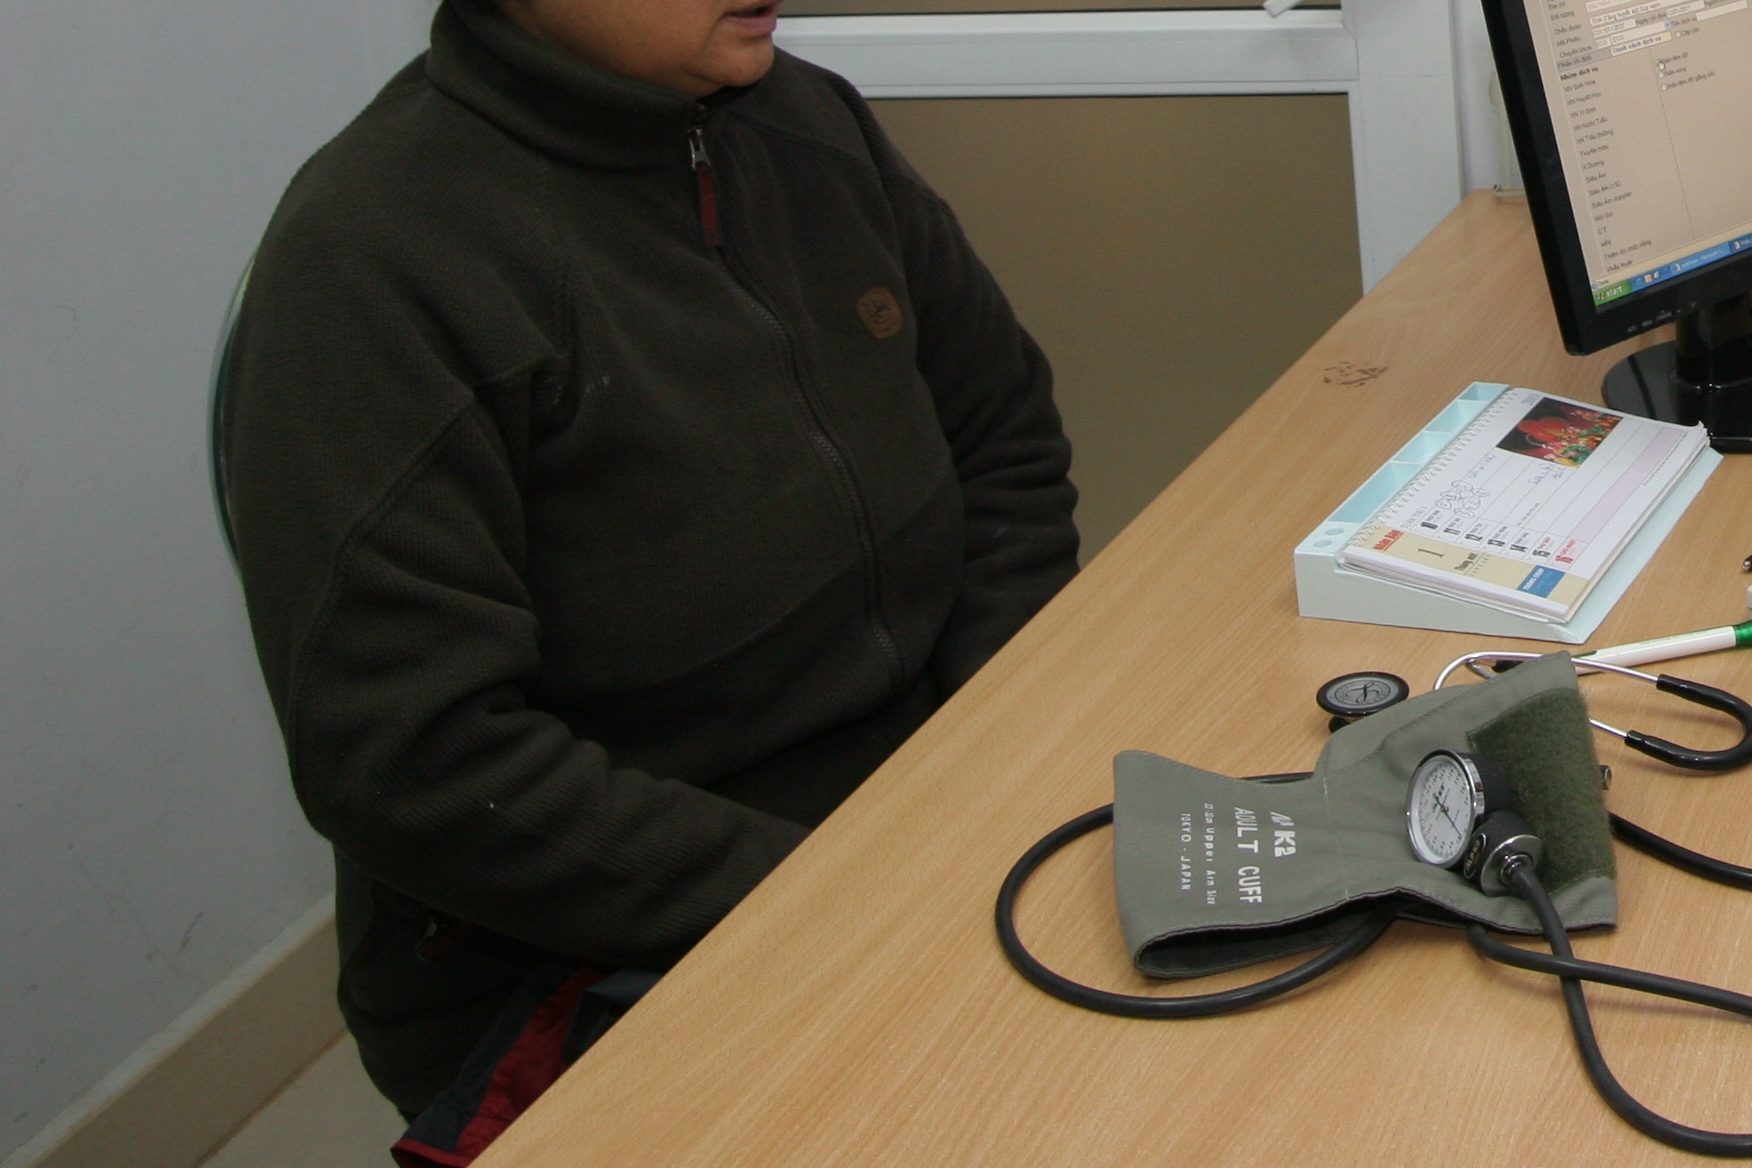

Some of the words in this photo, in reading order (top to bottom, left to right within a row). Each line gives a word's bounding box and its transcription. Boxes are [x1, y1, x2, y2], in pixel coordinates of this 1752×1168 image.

[1597, 226, 1608, 235] CT
[1606, 285, 1623, 298] start
[1181, 813, 1192, 843] TOKYO
[1234, 806, 1259, 854] ADULT
[1203, 827, 1216, 862] Upper
[1180, 855, 1192, 890] JAPAN
[1206, 869, 1217, 886] Arm
[1237, 866, 1263, 904] CUFF
[1206, 890, 1218, 905] Size
